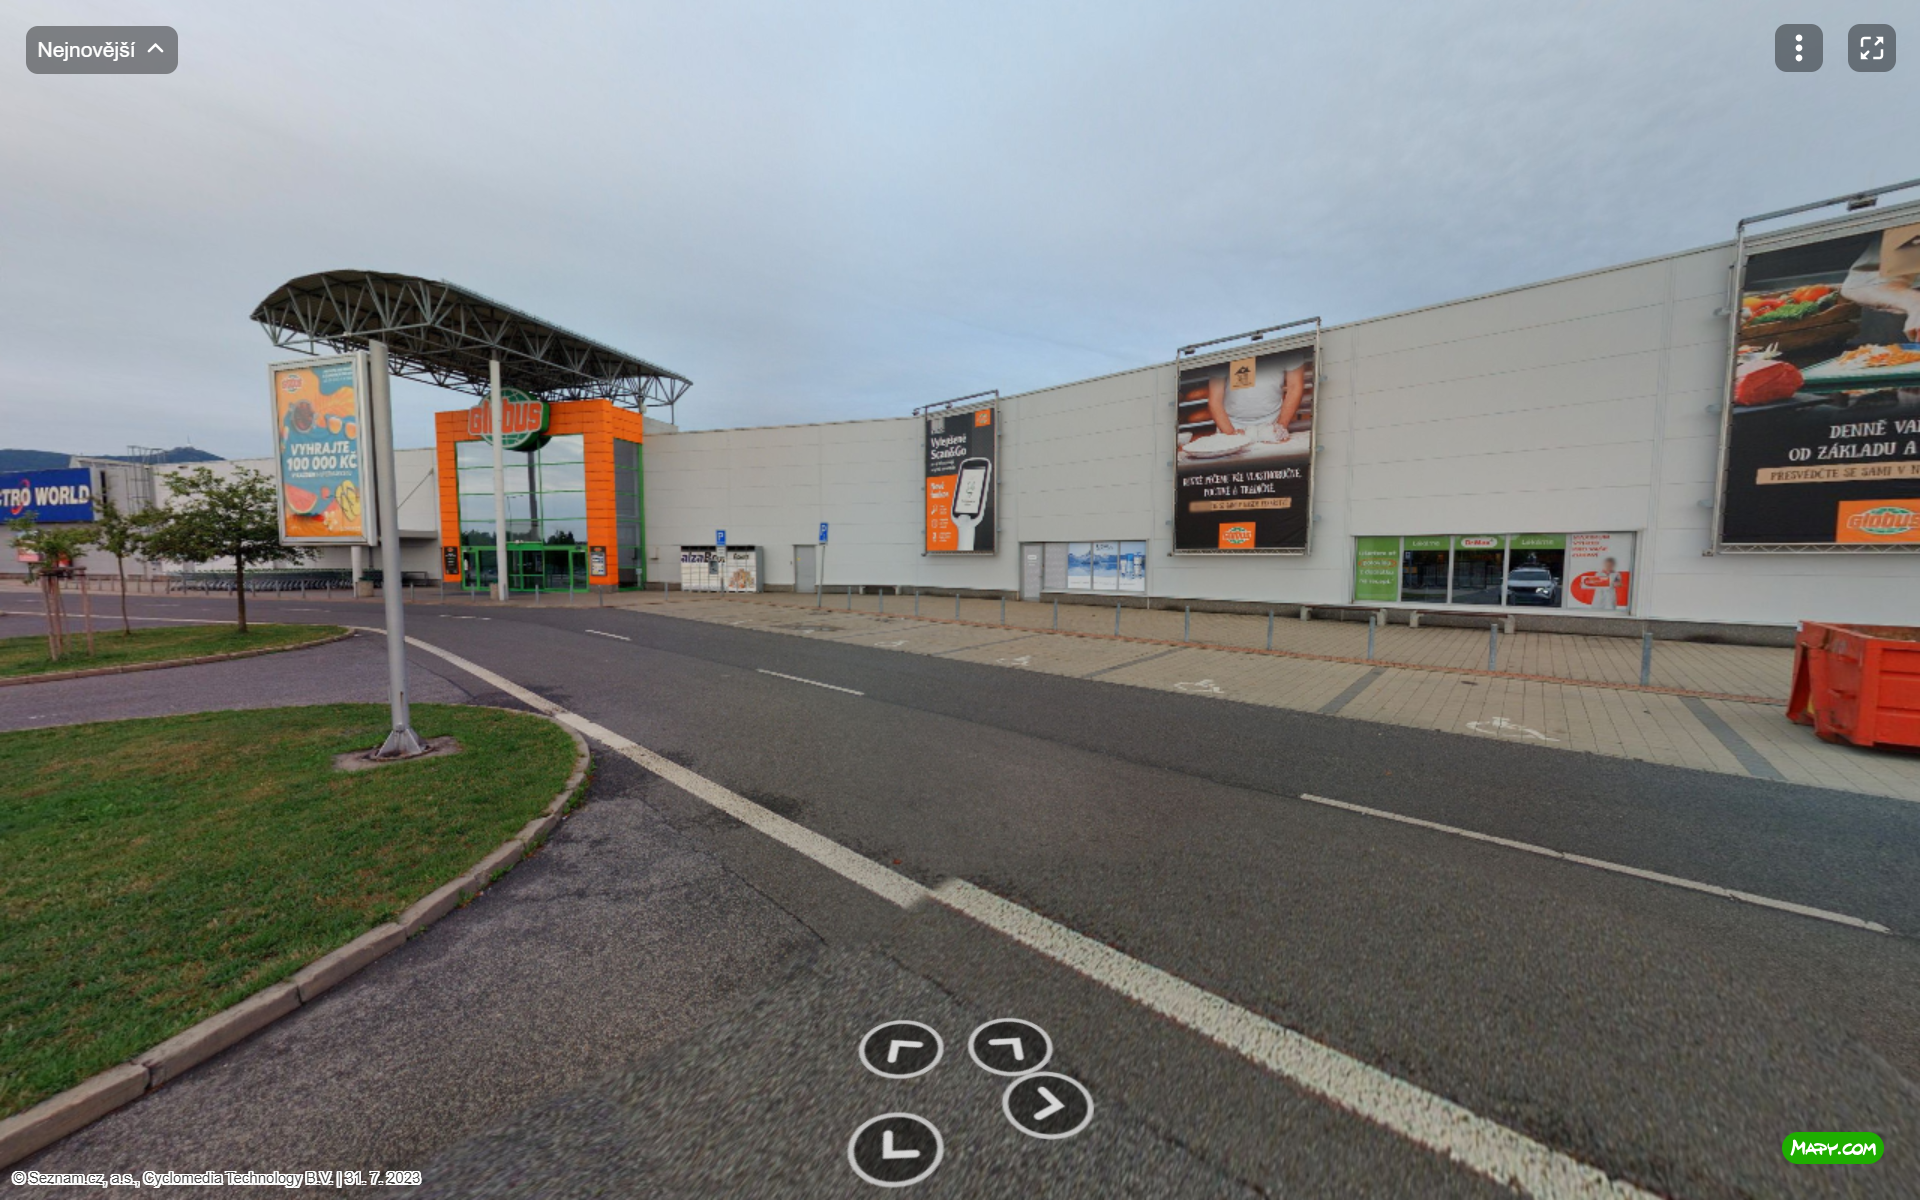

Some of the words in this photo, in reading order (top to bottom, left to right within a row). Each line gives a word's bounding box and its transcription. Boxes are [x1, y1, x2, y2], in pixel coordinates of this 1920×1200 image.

[469, 397, 543, 434] Glbus
[1894, 418, 1920, 435] VA
[291, 441, 350, 456] VYHRAJTE
[1789, 448, 1812, 461] OD
[1817, 442, 1897, 460] ZÁKLADU
[1903, 440, 1917, 455] A
[287, 458, 310, 471] 100
[311, 456, 337, 470] 000
[340, 450, 358, 469] KČ
[1843, 467, 1857, 477] SE
[1861, 465, 1892, 476] SAMI
[1897, 465, 1907, 474] V
[35, 485, 91, 506] WORLD
[1848, 511, 1920, 528] Globus
[717, 532, 724, 543] P
